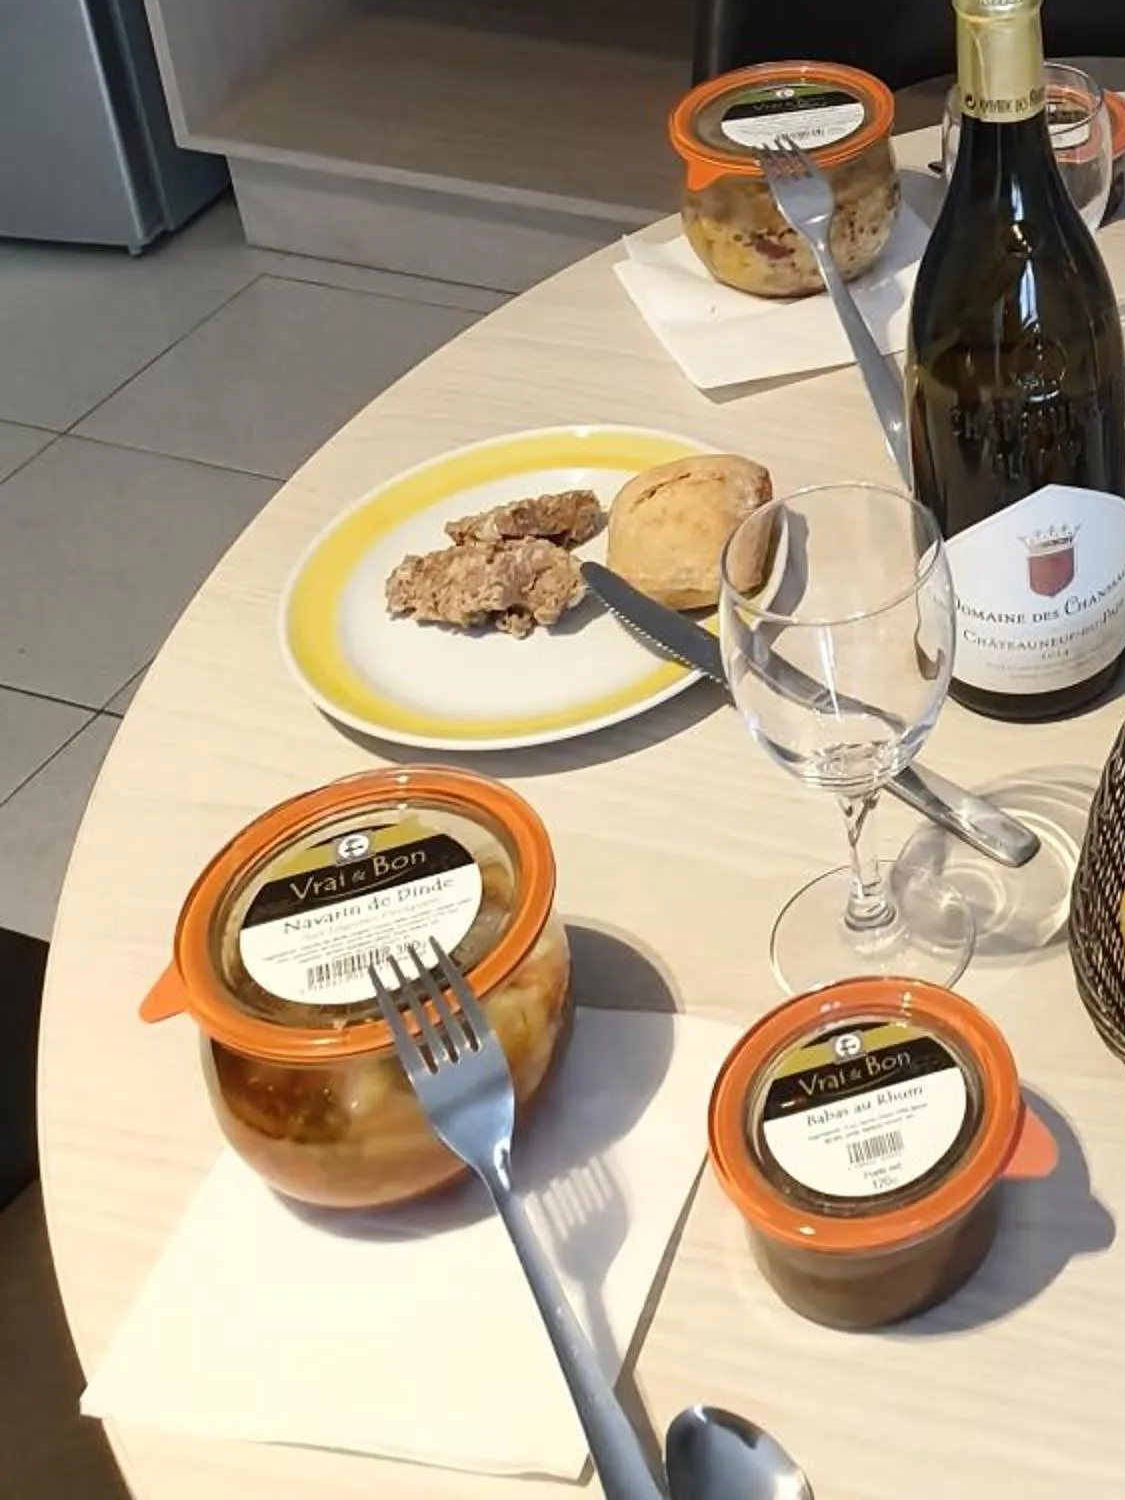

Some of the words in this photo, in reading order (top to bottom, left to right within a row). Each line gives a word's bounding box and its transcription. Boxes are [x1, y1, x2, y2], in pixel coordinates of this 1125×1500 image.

[289, 869, 346, 900] Vrai
[373, 850, 427, 877] Bon
[799, 1068, 846, 1096] Vrai
[866, 1051, 912, 1076] Bon
